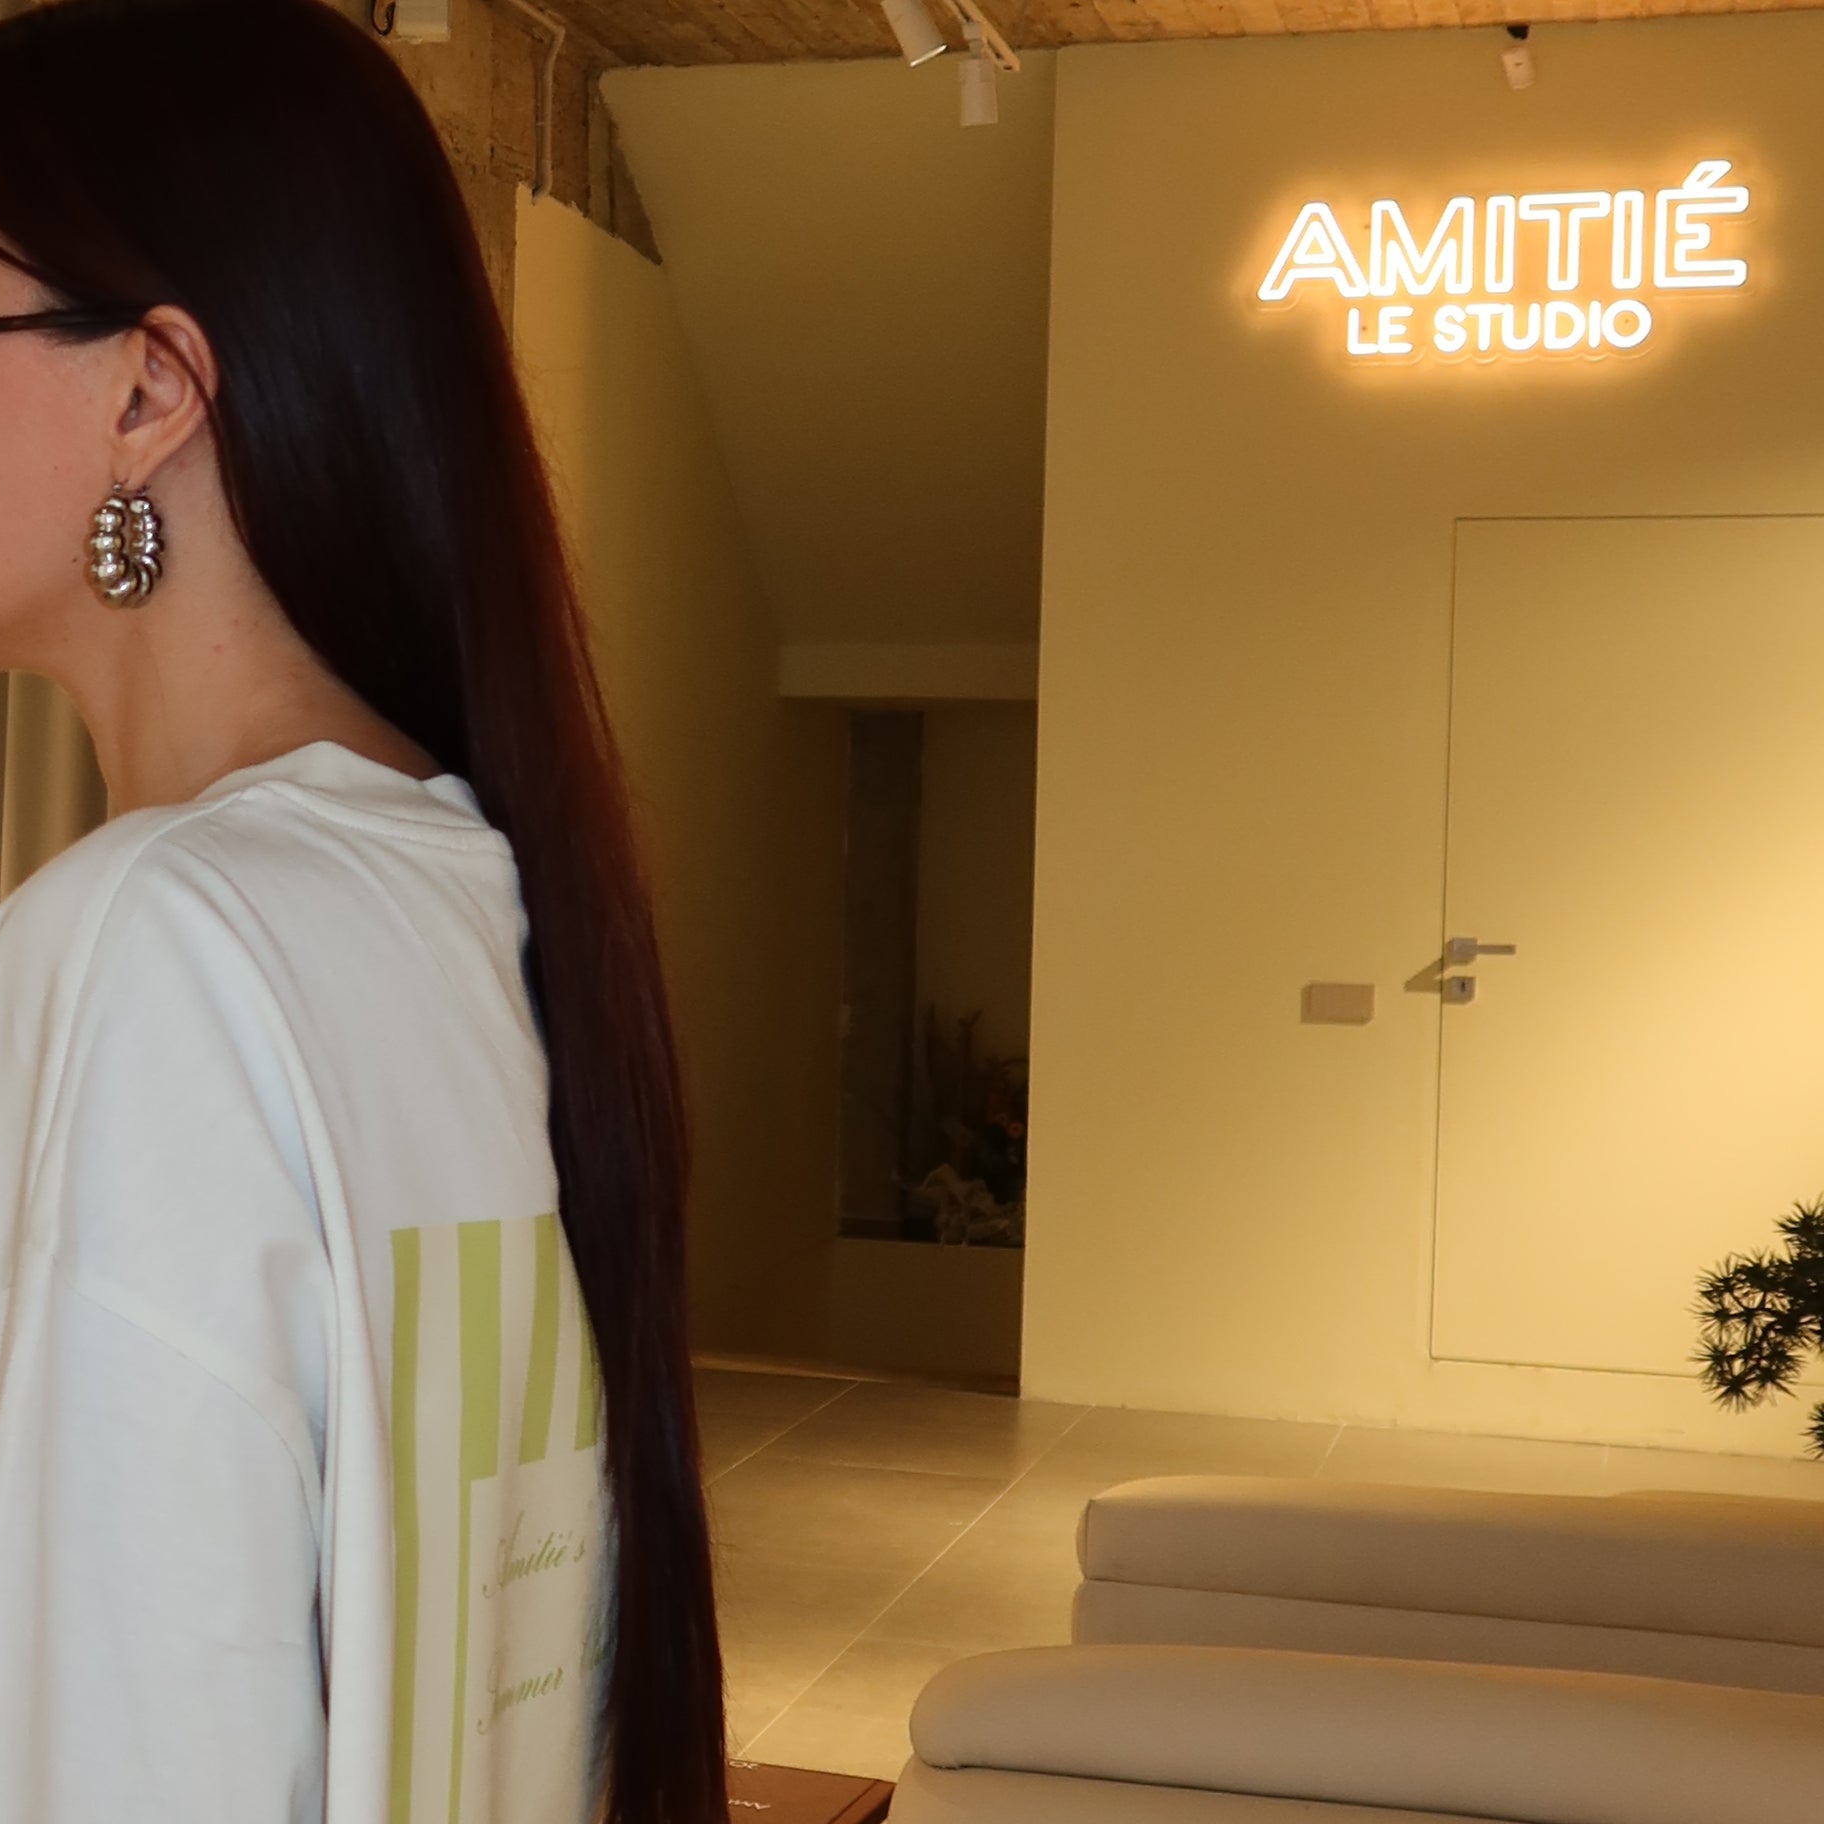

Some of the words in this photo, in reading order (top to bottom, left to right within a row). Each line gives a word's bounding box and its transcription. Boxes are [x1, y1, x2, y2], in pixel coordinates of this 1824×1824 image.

[1257, 159, 1750, 302] AMITIÉ
[1346, 305, 1414, 355] LE
[1433, 298, 1653, 353] STUDIO
